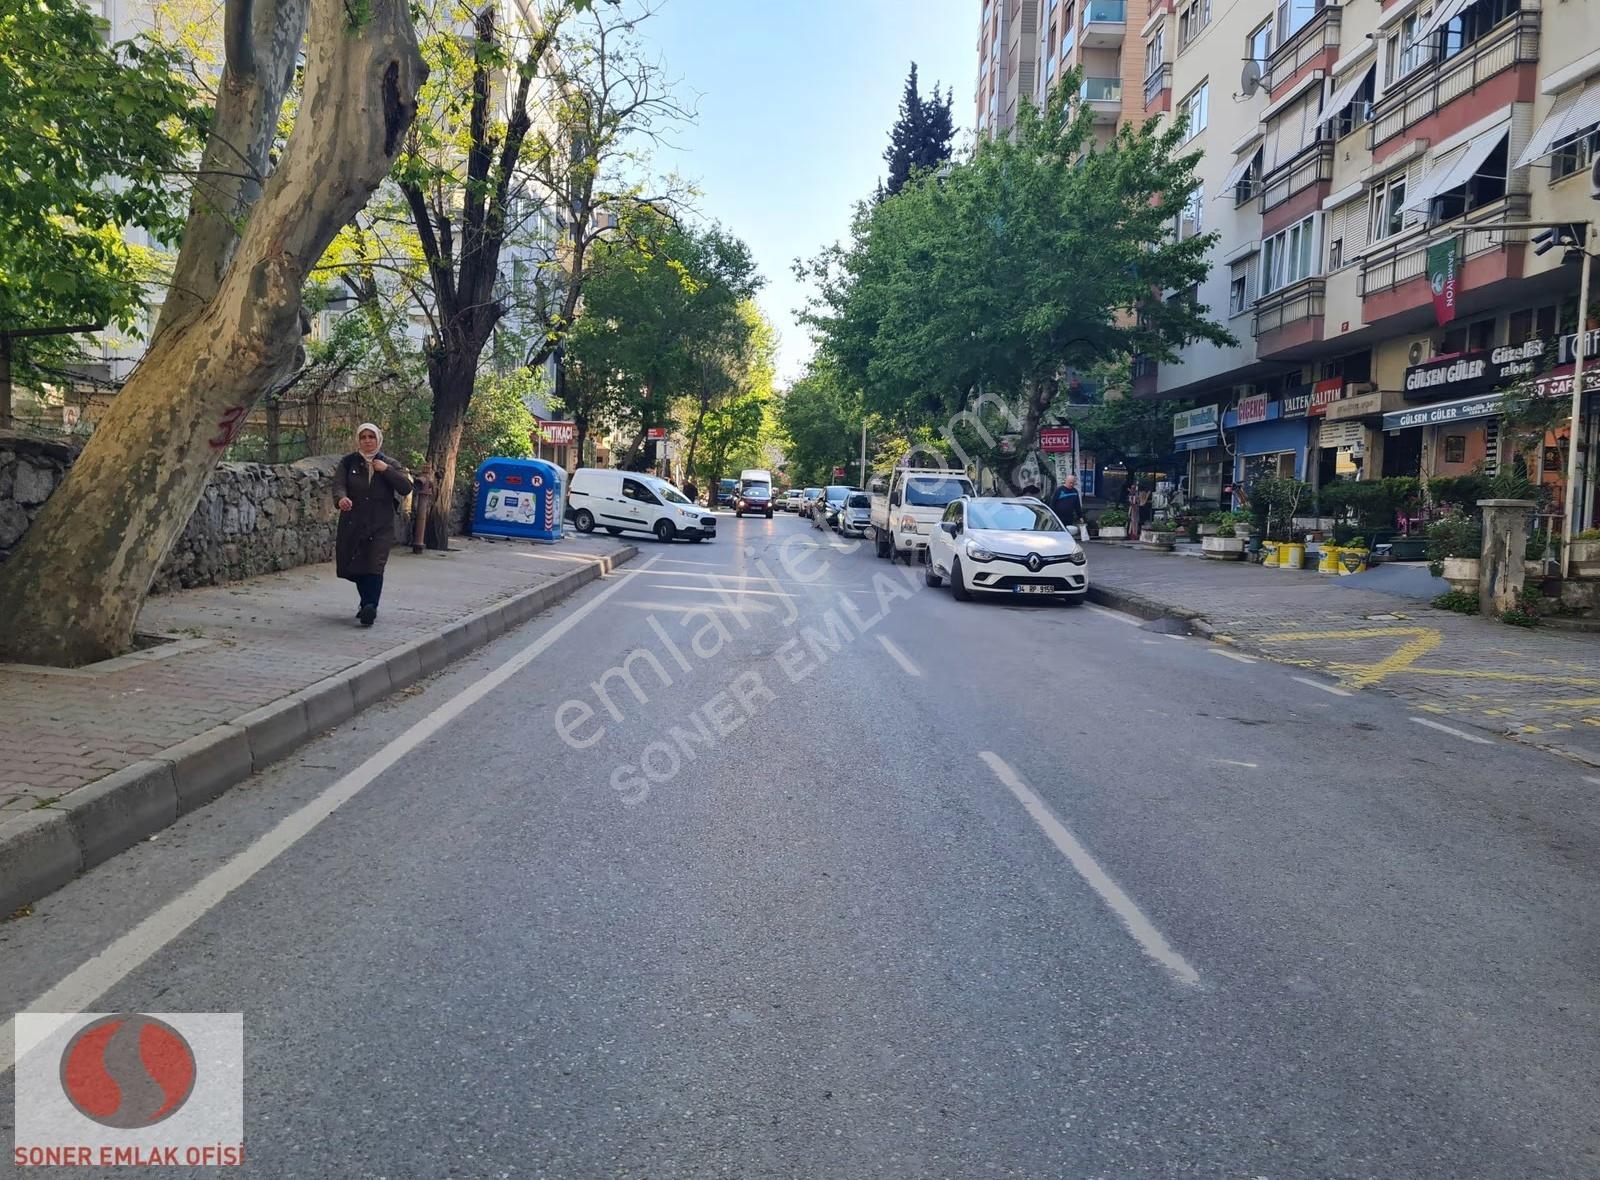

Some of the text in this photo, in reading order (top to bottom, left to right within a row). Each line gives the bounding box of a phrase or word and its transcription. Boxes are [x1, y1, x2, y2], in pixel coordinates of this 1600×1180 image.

[1447, 359, 1486, 383] GÜLER
[1550, 379, 1579, 394] CAF
[1284, 395, 1310, 412] YALTEK
[1431, 408, 1457, 421] GÜLER
